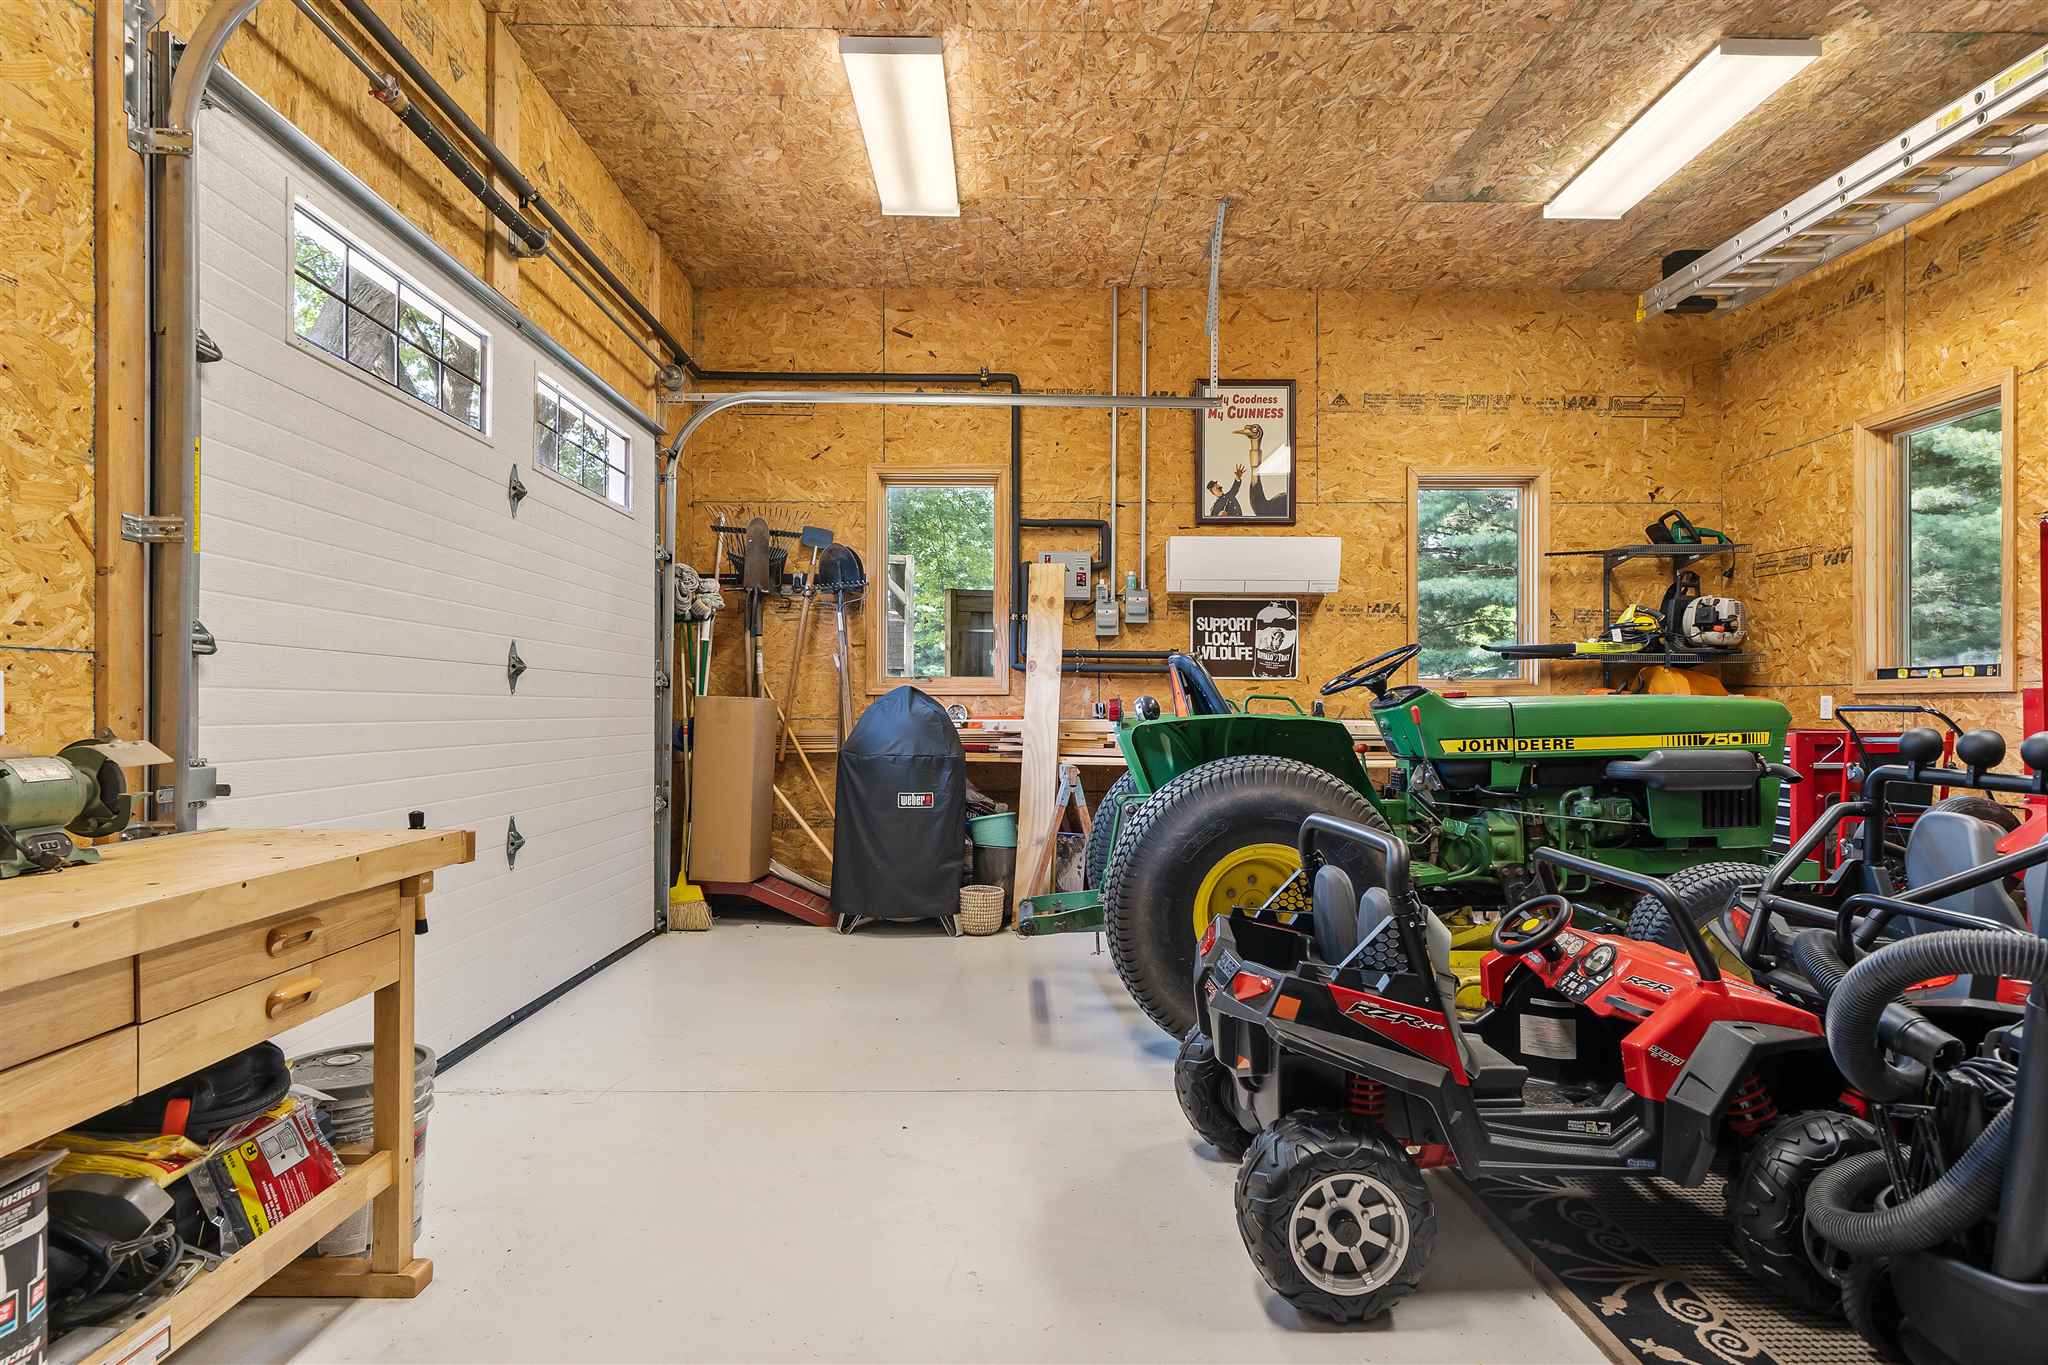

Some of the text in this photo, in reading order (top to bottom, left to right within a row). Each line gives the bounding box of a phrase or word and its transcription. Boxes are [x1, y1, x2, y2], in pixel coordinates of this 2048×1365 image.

[1232, 393, 1279, 404] Goodness
[1208, 405, 1285, 421] My GUINNESS
[1196, 616, 1253, 632] SUPPORT
[1204, 631, 1245, 646] LOCAL
[1457, 738, 1575, 752] JOHN DEERE
[1701, 733, 1743, 745] 750
[1344, 1002, 1423, 1028] RZR
[246, 1143, 258, 1156] R
